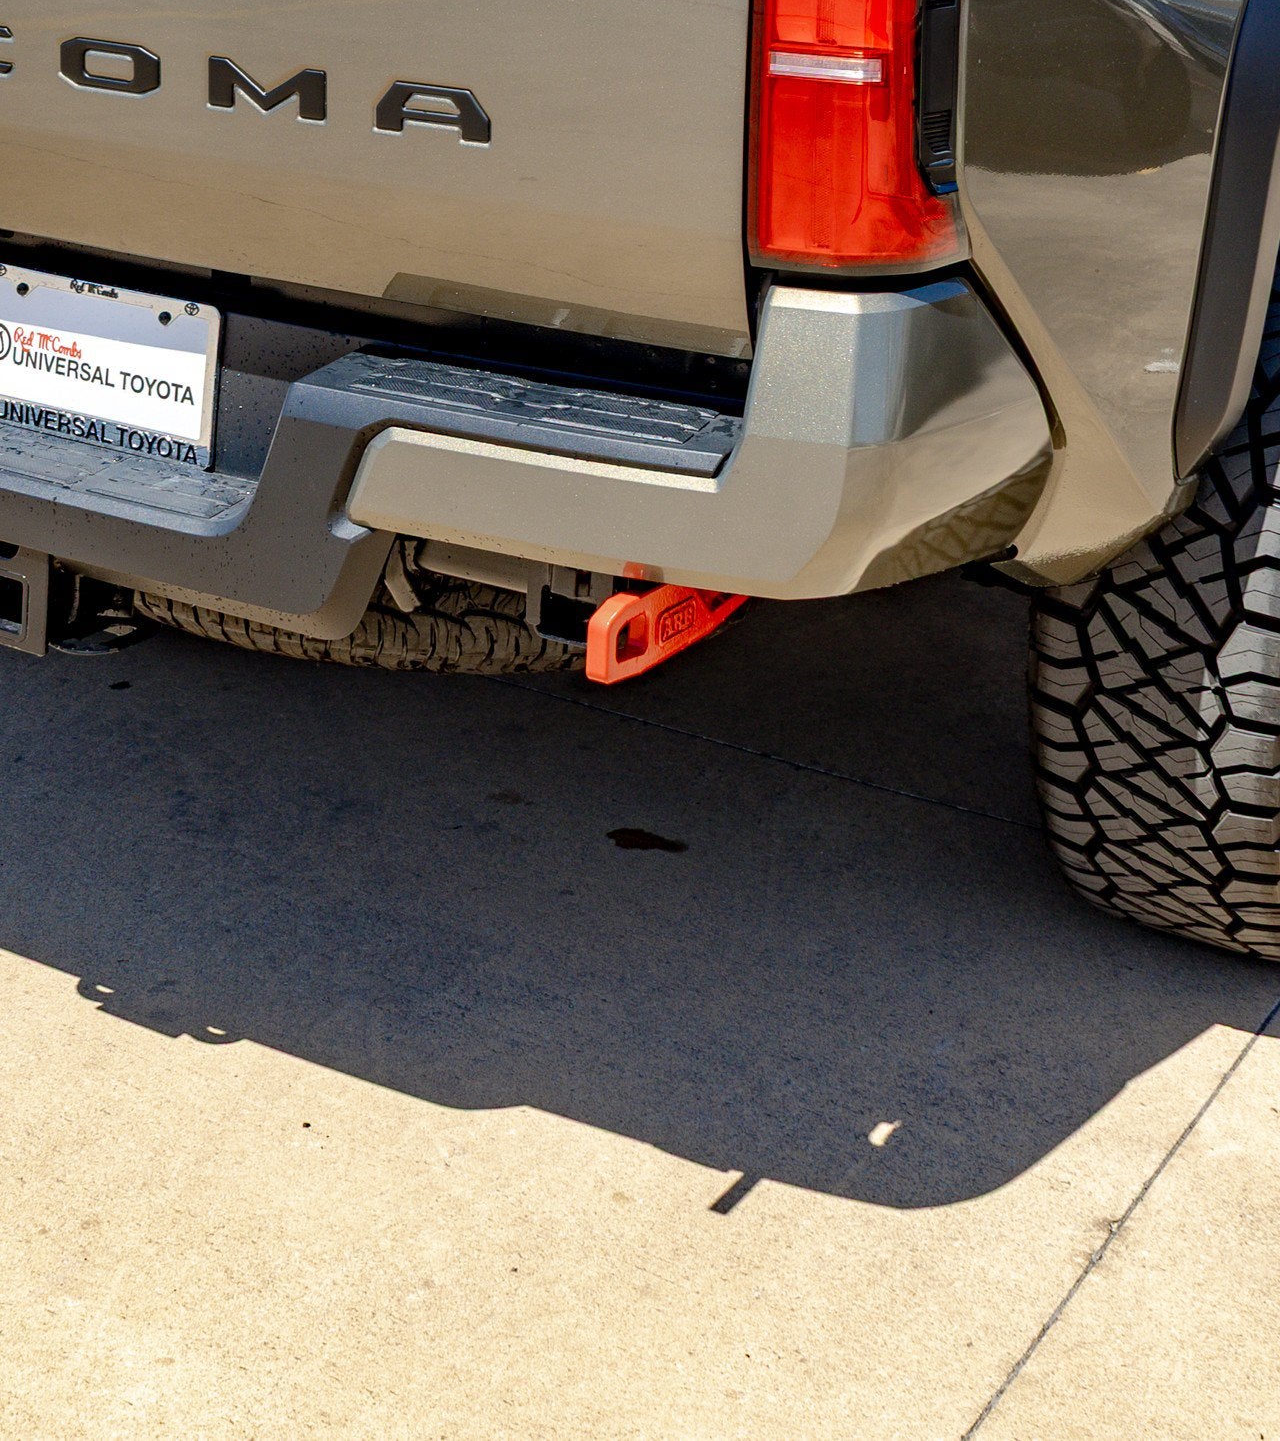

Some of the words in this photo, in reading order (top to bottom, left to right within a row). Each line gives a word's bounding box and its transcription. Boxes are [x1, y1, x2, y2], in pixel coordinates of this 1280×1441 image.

[14, 327, 34, 348] Red
[37, 332, 82, 360] McCombs
[13, 346, 115, 388] UNIVERSAL
[119, 371, 195, 406] TOYOTA
[116, 424, 199, 465] TOYOTA
